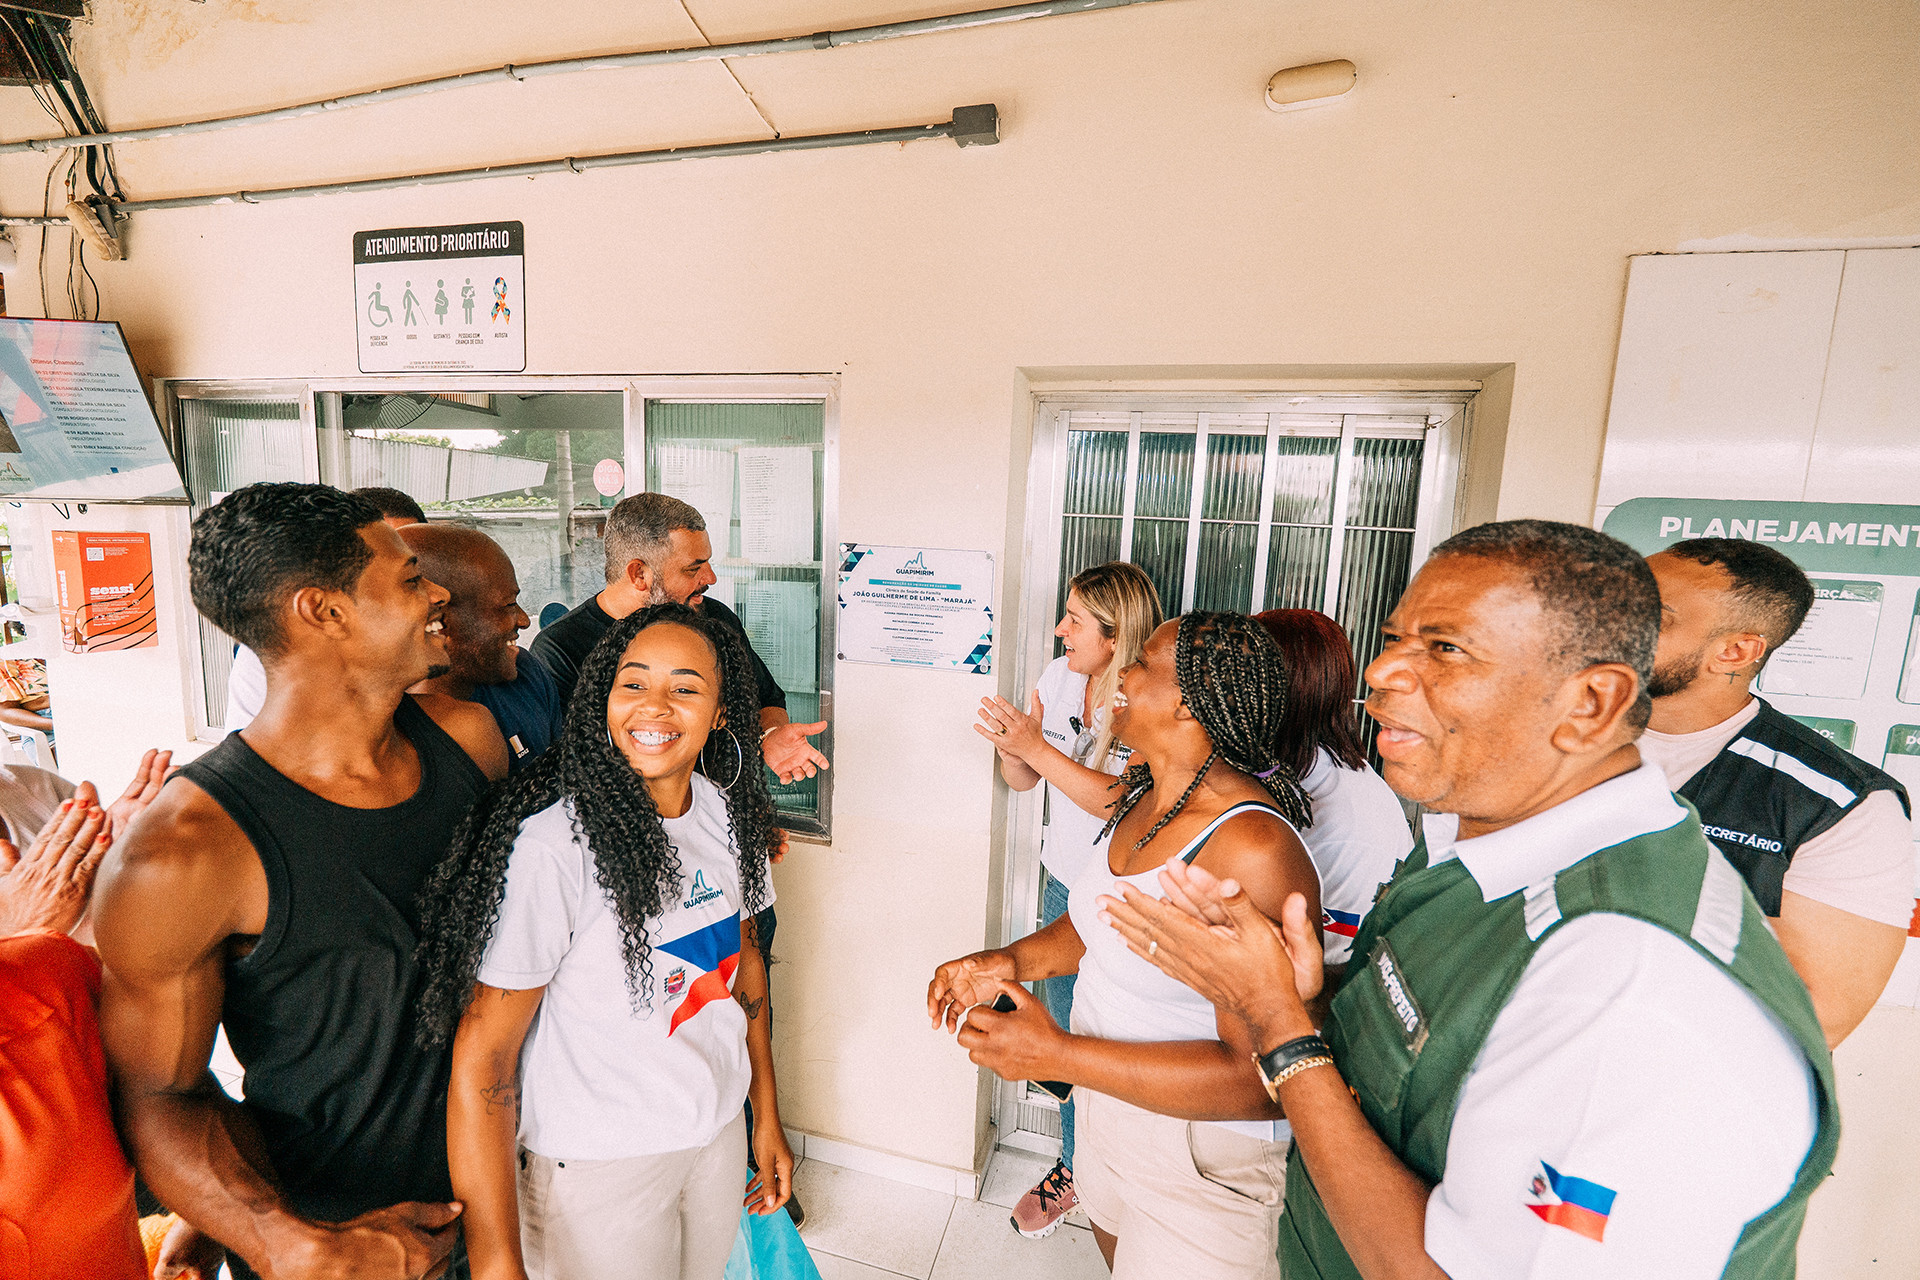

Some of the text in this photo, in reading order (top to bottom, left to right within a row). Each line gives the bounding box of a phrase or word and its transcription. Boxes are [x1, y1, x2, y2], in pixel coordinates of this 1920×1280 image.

[365, 228, 510, 256] ATENDIMENTO PRIORITÁRIO
[90, 583, 135, 595] sensi
[1812, 588, 1853, 601] ERÇA
[683, 889, 724, 909] GUAPIMIRIM
